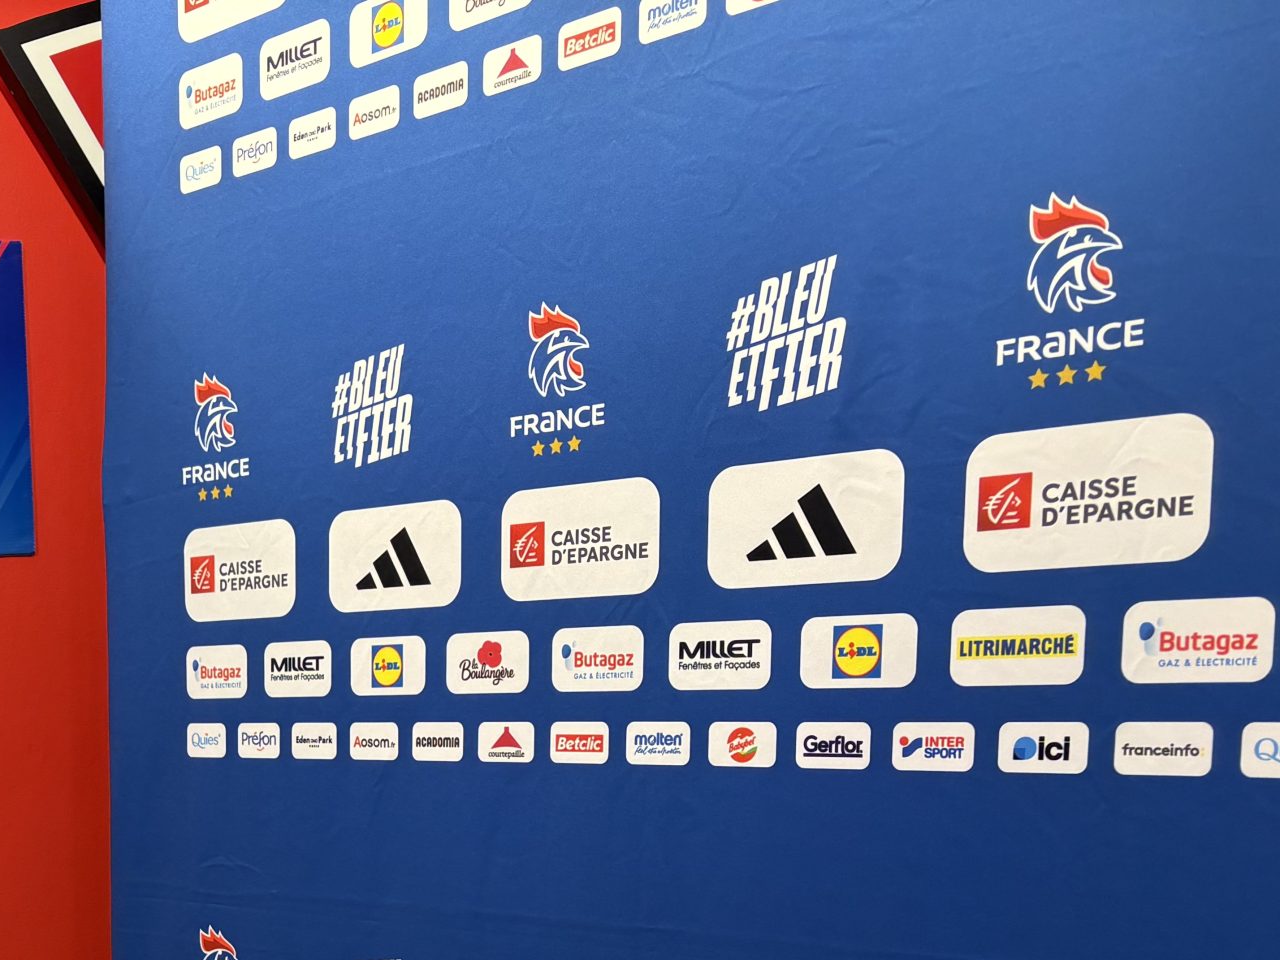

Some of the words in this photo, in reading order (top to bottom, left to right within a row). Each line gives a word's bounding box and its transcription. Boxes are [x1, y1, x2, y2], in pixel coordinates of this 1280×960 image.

[566, 26, 615, 55] Betclic
[266, 36, 322, 72] MILLET
[494, 70, 532, 89] courtepaille
[194, 78, 237, 104] Butagaz
[417, 78, 464, 104] ACADOMIA
[293, 130, 308, 143] Eden
[316, 122, 332, 134] Park
[237, 140, 273, 164] Préfon
[726, 254, 838, 352] #BLEU
[331, 343, 405, 419] #BLEU
[1041, 475, 1137, 504] CAISSE
[1041, 495, 1194, 528] D'EPARGNE
[551, 526, 612, 547] CAISSE
[552, 542, 649, 566] D'EPARGNE
[219, 559, 262, 577] CAISSE
[220, 573, 288, 592] D'EPARGNE
[678, 639, 761, 659] MILLET
[959, 634, 1075, 657] LITRIMARCHÉ
[1159, 630, 1258, 655] Butagaz
[271, 656, 324, 672] MILLET
[471, 659, 479, 669] la
[574, 651, 634, 671] Butagaz
[678, 661, 712, 671] Fenêtres
[714, 661, 722, 670] et
[724, 660, 760, 671] Façades
[1158, 658, 1179, 668] GAZ
[1195, 655, 1258, 667] ÉLECTRICITÉ
[200, 665, 241, 681] Butagaz
[459, 658, 515, 685] Boulangère
[595, 671, 633, 680] ÉLECTRICITÉ
[192, 733, 219, 749] Quies
[241, 731, 276, 747] Préfon
[296, 736, 310, 744] Eden
[318, 736, 332, 744] Park
[415, 736, 460, 748] ACADOMIA
[557, 736, 602, 751] Betclic
[634, 732, 681, 746] molten
[728, 735, 756, 753] Babybel
[924, 736, 964, 748] INTER
[1038, 736, 1070, 761] ici
[488, 750, 525, 759] courtepaille
[924, 747, 964, 759] SPORT
